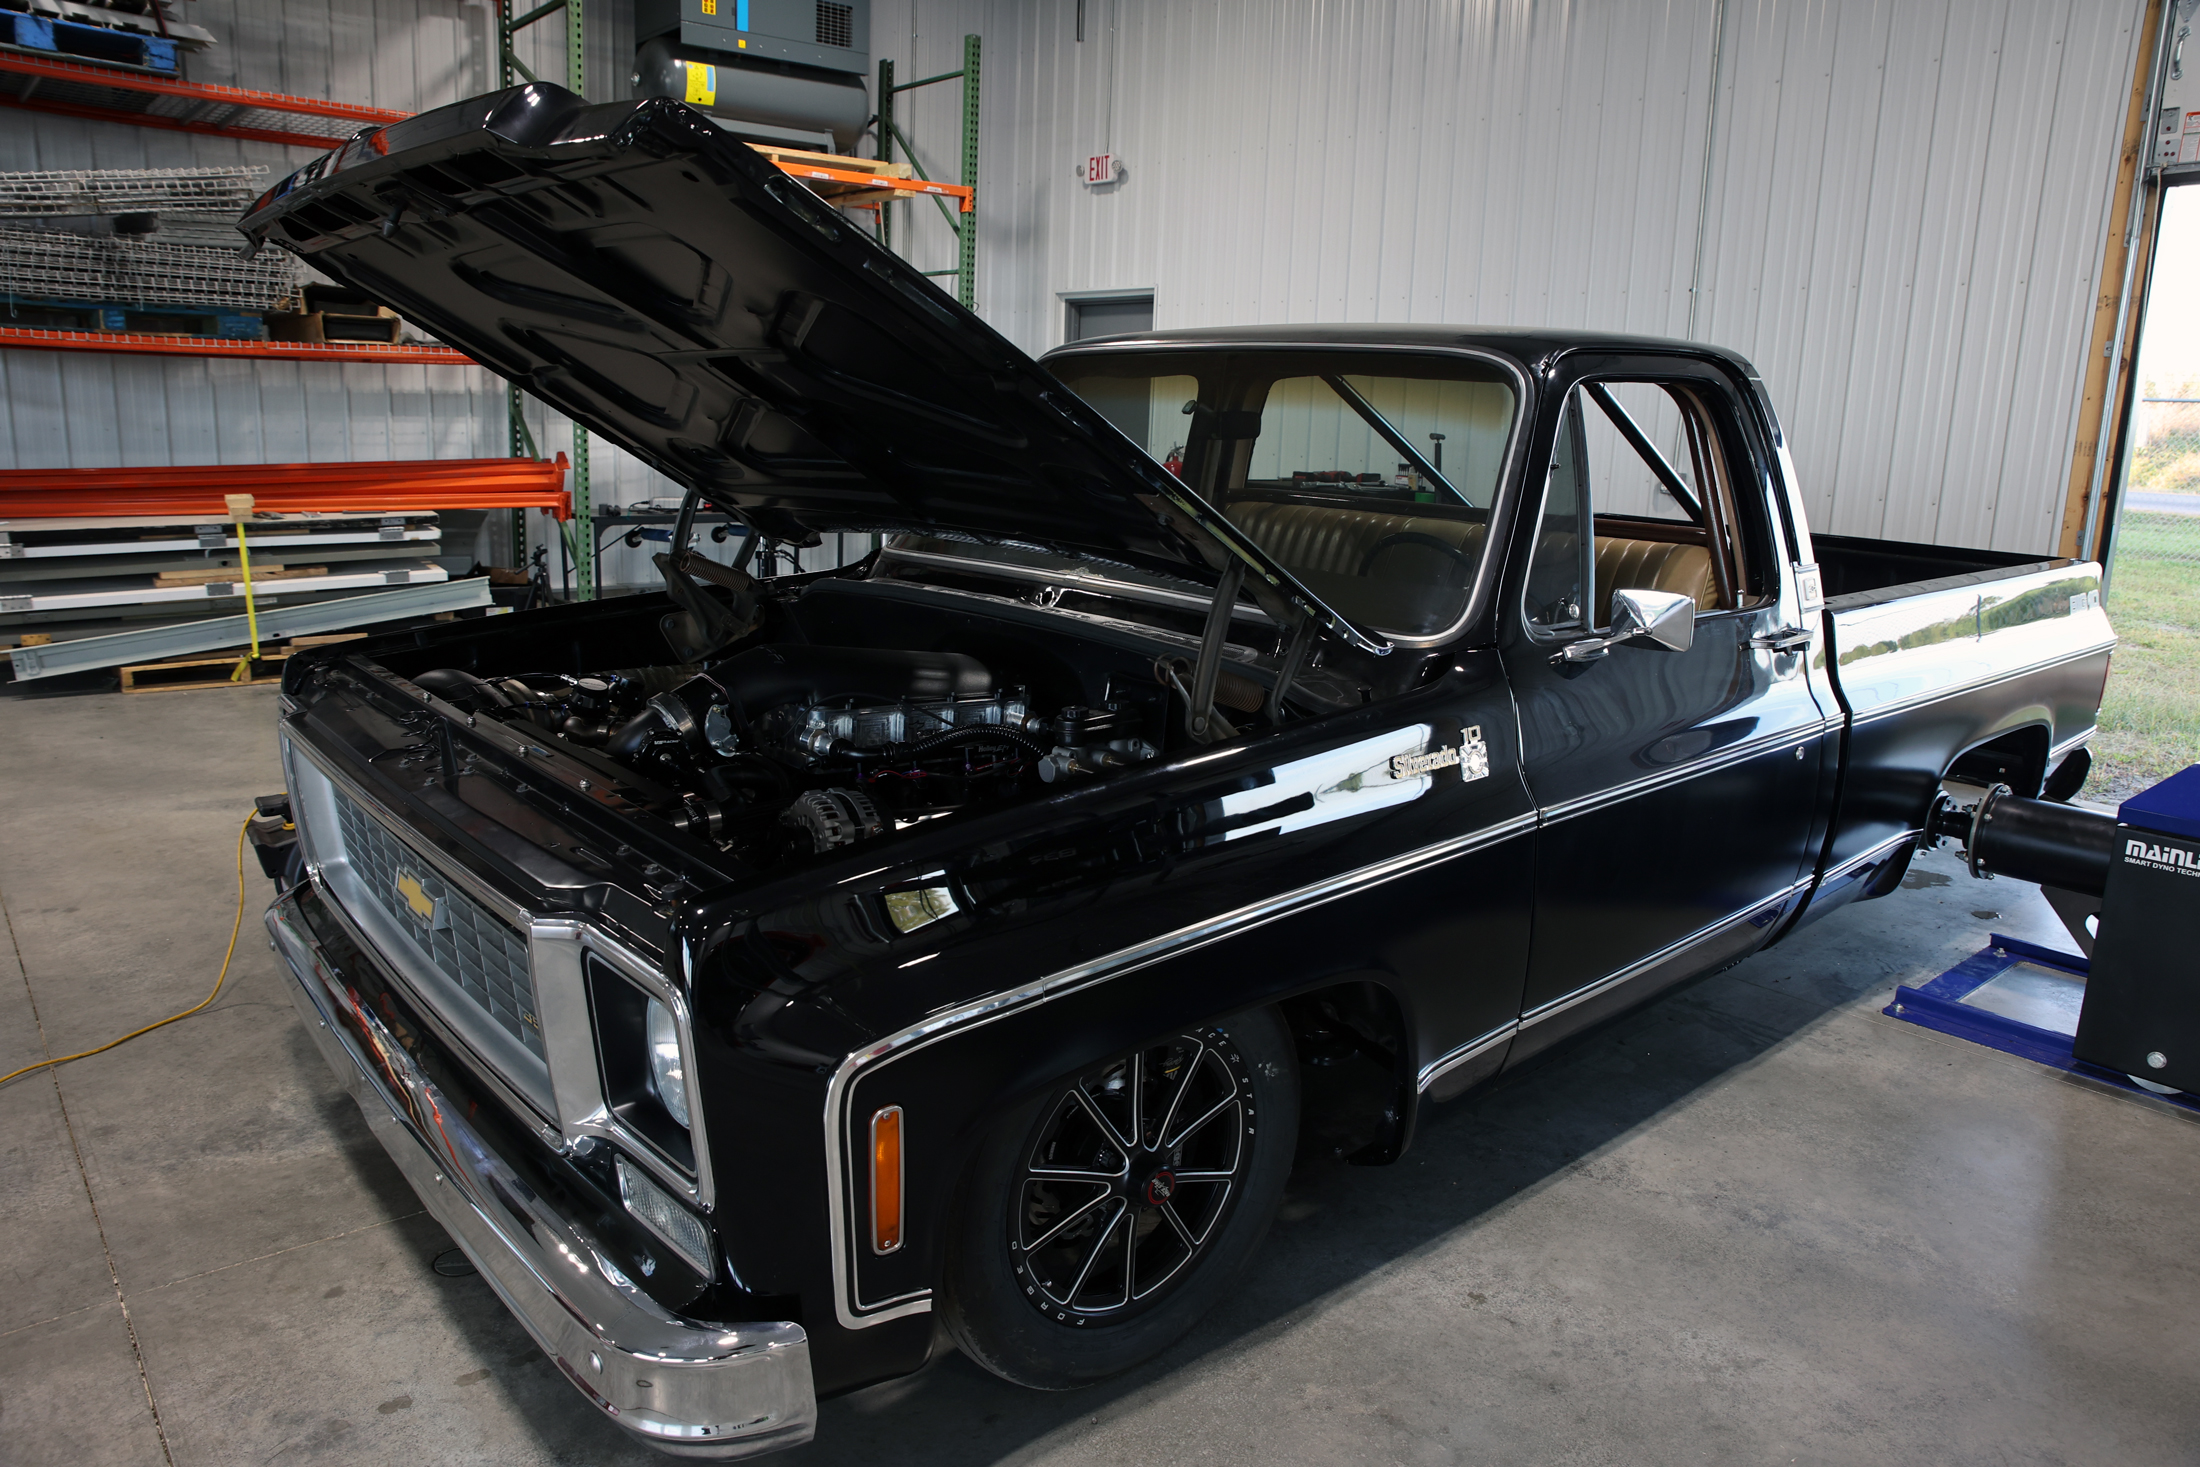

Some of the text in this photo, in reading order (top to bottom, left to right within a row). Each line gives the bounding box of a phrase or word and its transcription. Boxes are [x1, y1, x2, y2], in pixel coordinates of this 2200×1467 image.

[1089, 155, 1110, 182] EXIT
[1460, 725, 1482, 746] 10
[1391, 745, 1460, 779] Silverado
[2124, 856, 2152, 868] SMART
[2152, 862, 2176, 872] DYNO
[1241, 1077, 1255, 1135] STAR
[1011, 1240, 1086, 1326] FORGED
